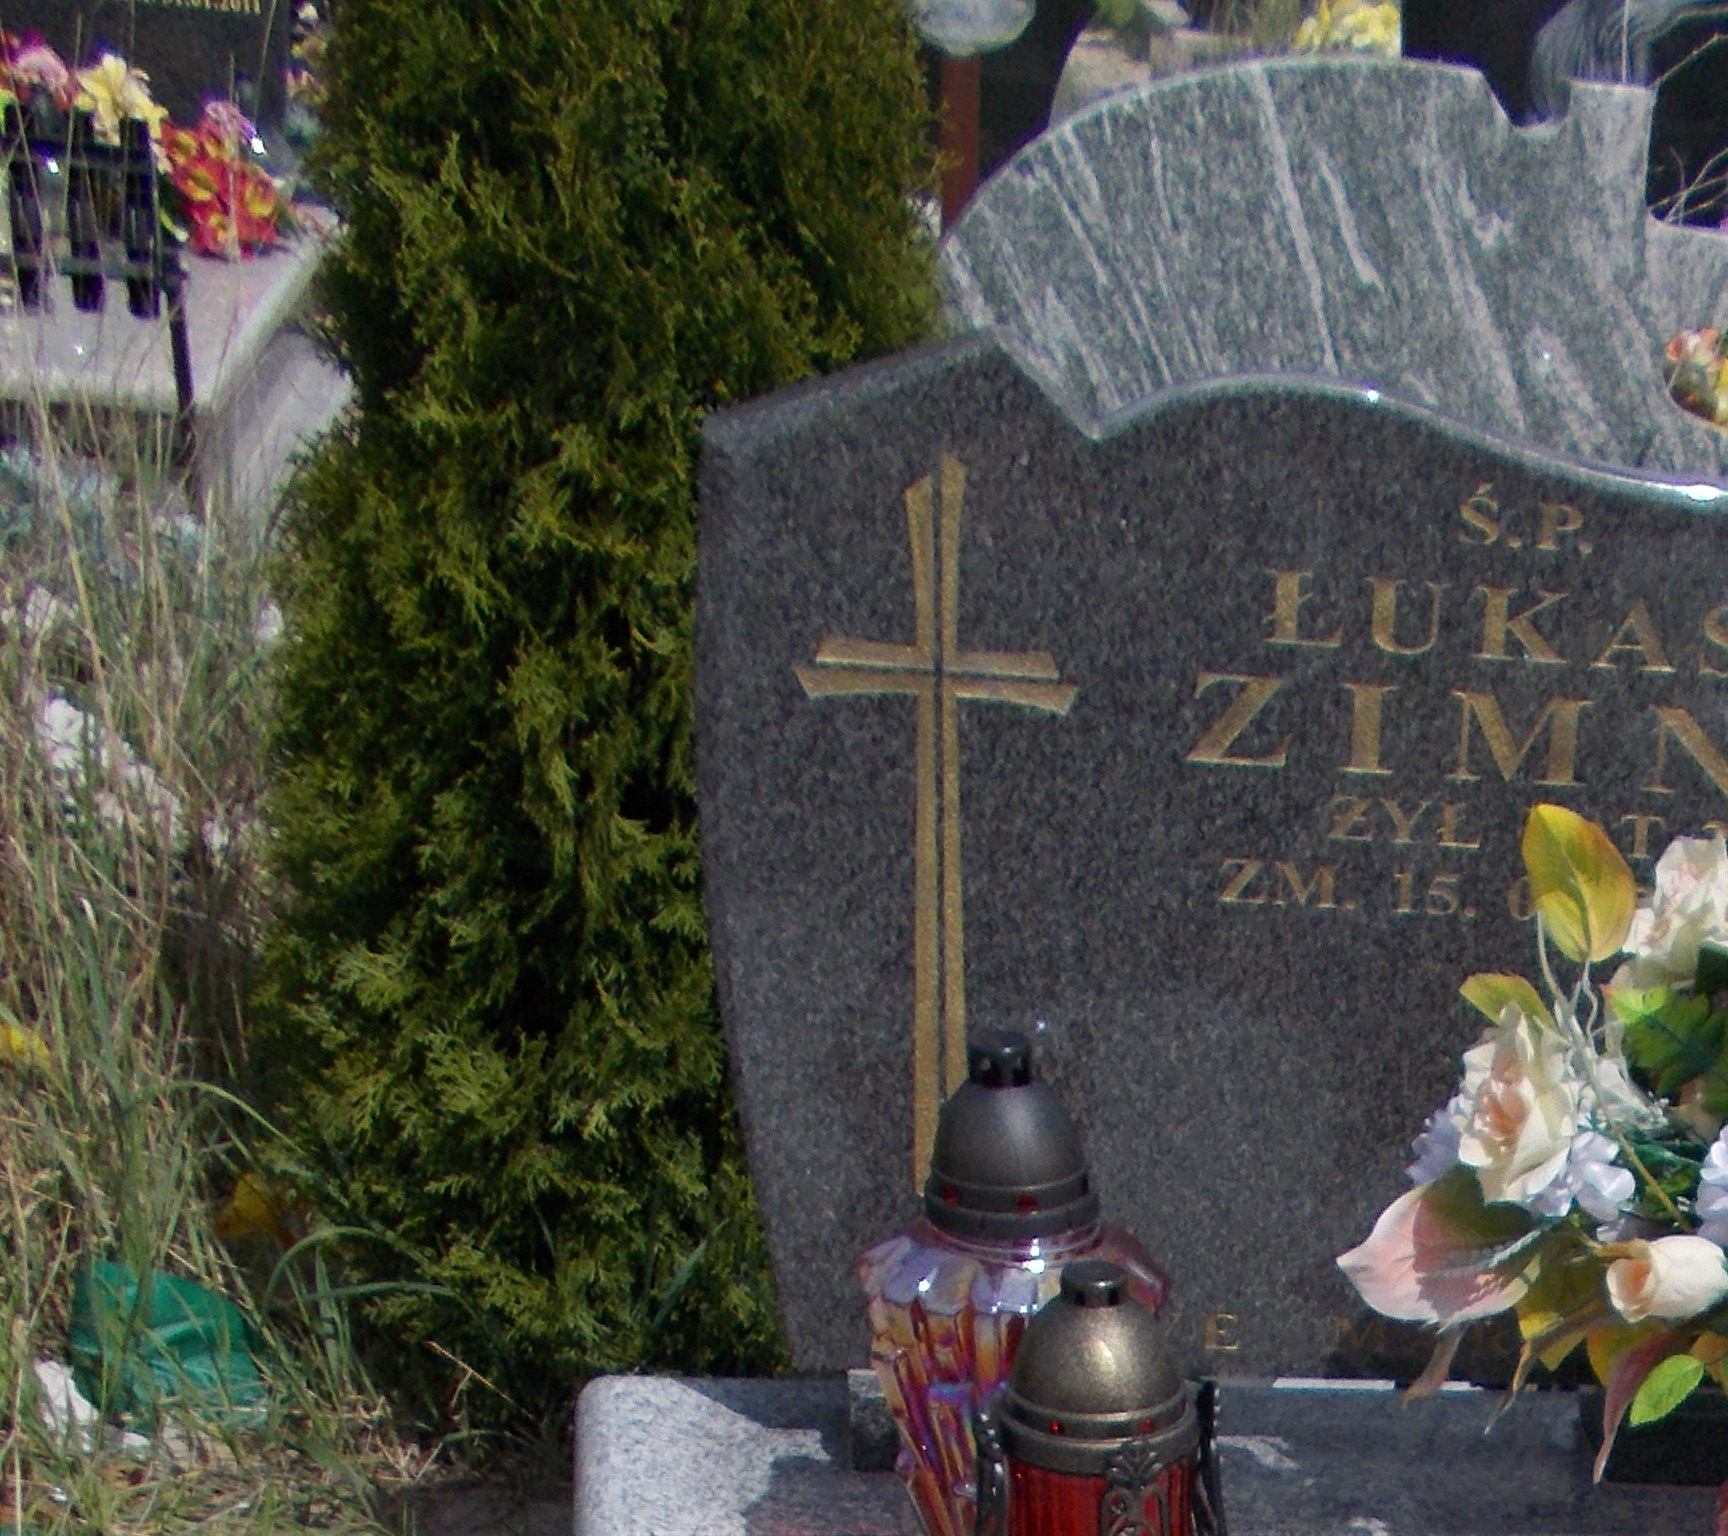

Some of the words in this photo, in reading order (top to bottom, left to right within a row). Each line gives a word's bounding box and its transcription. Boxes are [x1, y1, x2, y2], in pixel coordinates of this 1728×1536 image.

[1458, 482, 1594, 554] Ś.P.
[1216, 857, 1357, 910] ZM.
[1394, 871, 1479, 918] 15.
